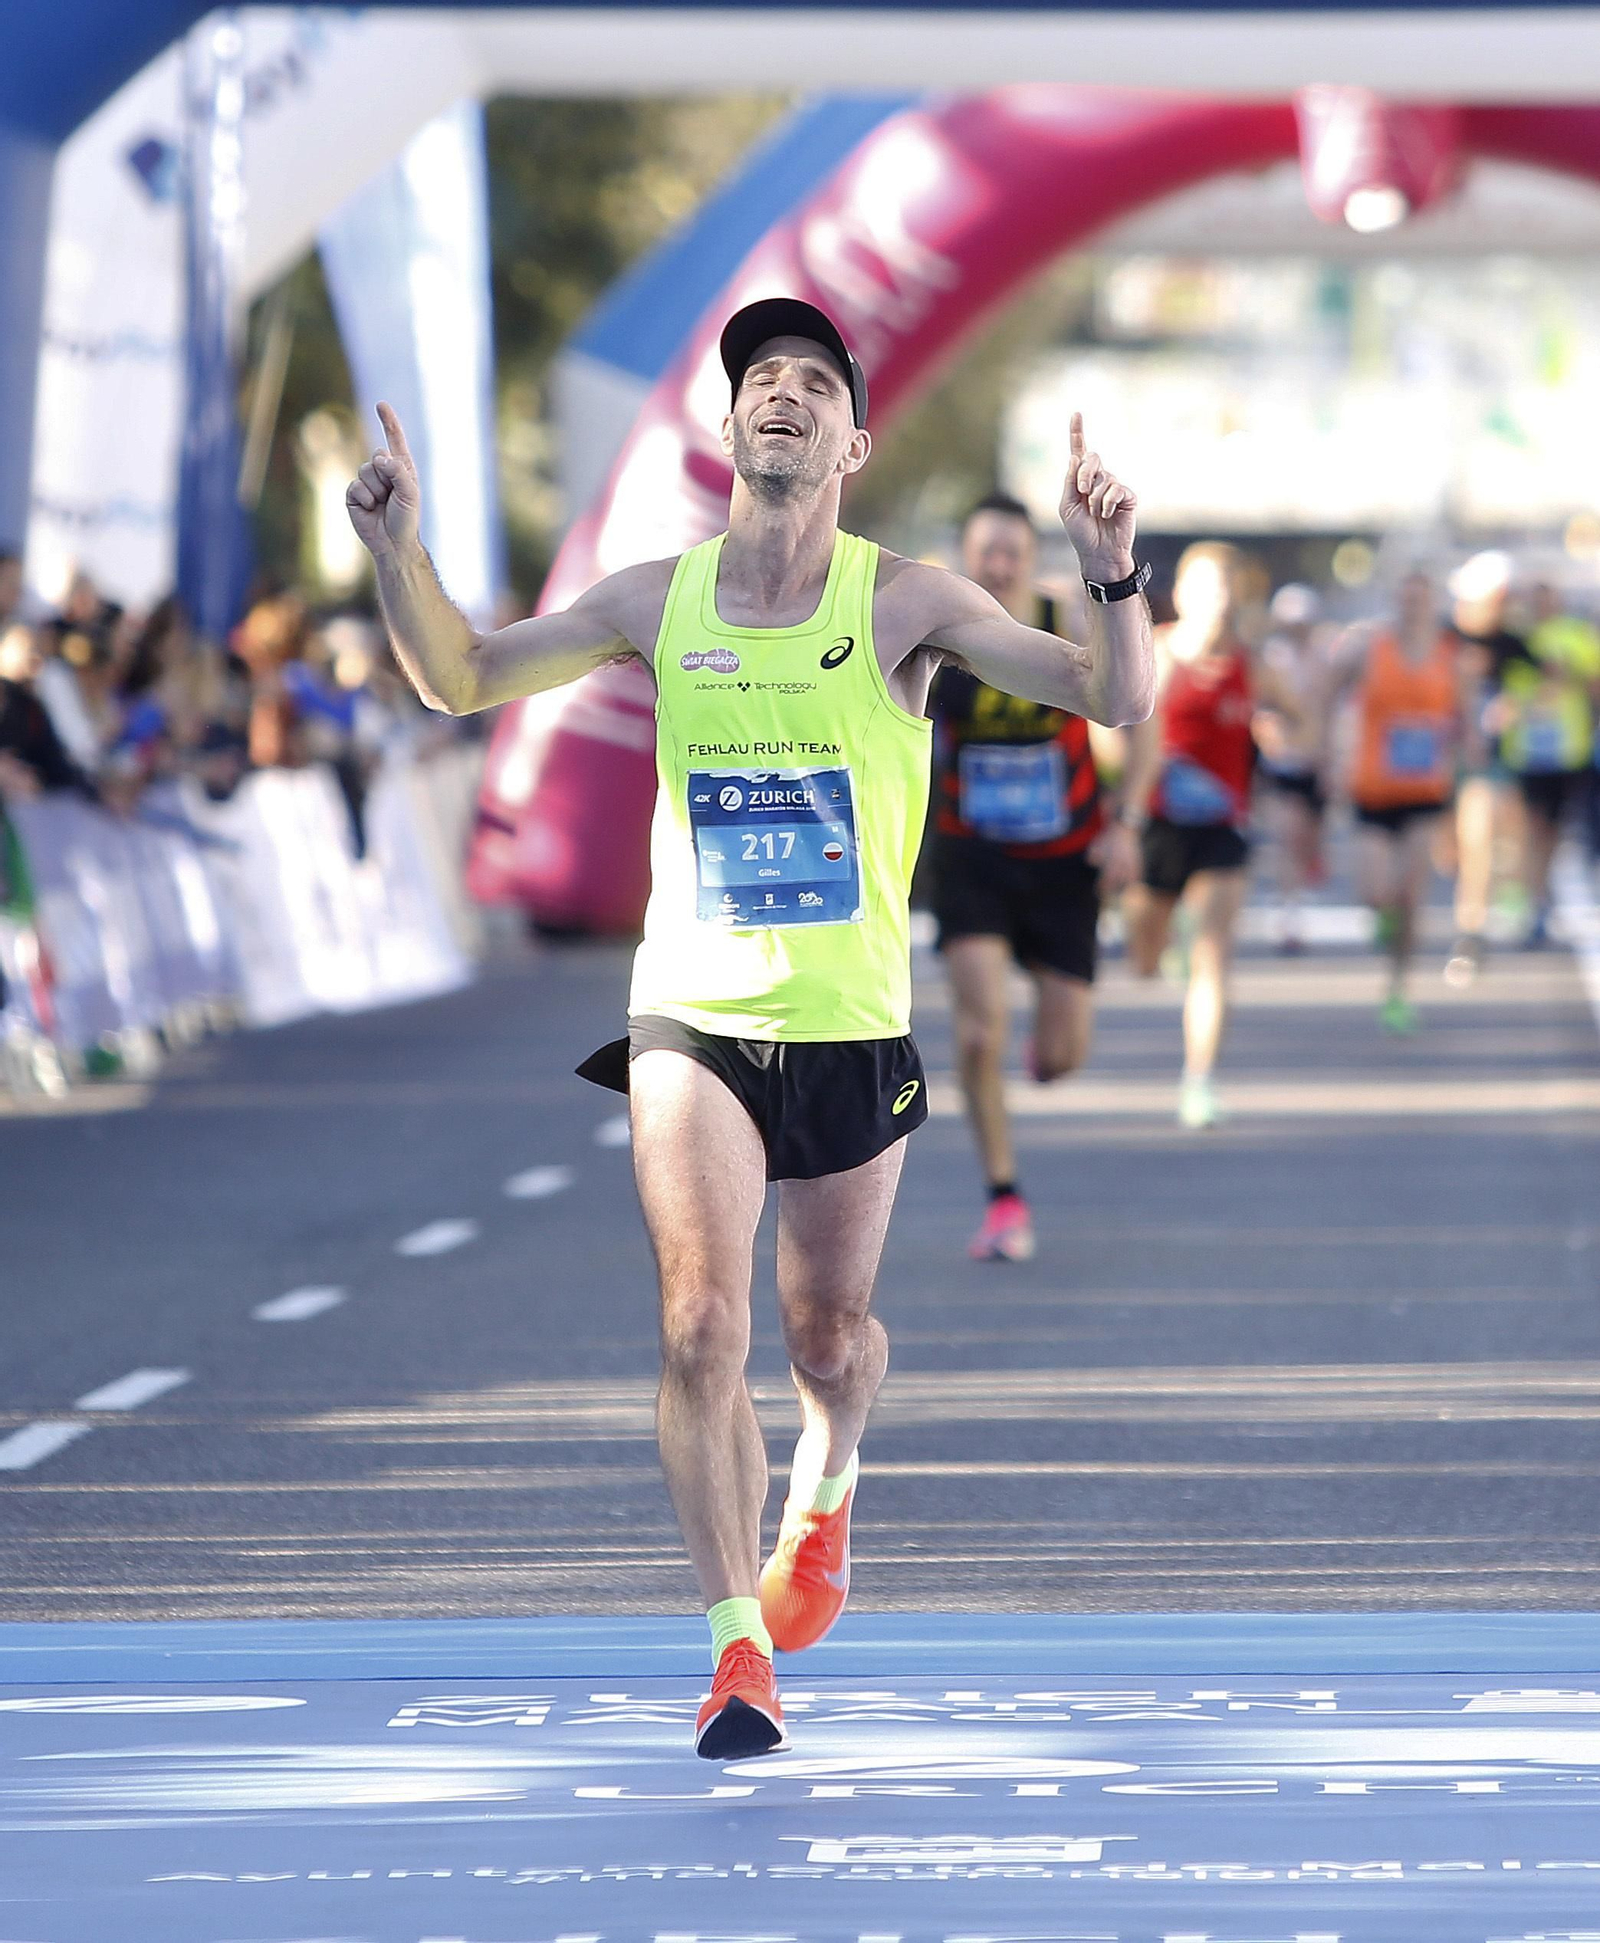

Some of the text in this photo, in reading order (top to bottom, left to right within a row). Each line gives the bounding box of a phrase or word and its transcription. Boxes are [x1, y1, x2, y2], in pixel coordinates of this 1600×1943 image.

[694, 682, 817, 691] Alliance Technology
[688, 741, 841, 757] FEHLAU RUN TEAM
[694, 794, 711, 803] 42K
[748, 789, 815, 805] ZURICH
[741, 832, 796, 861] 217
[758, 868, 781, 877] Gilles
